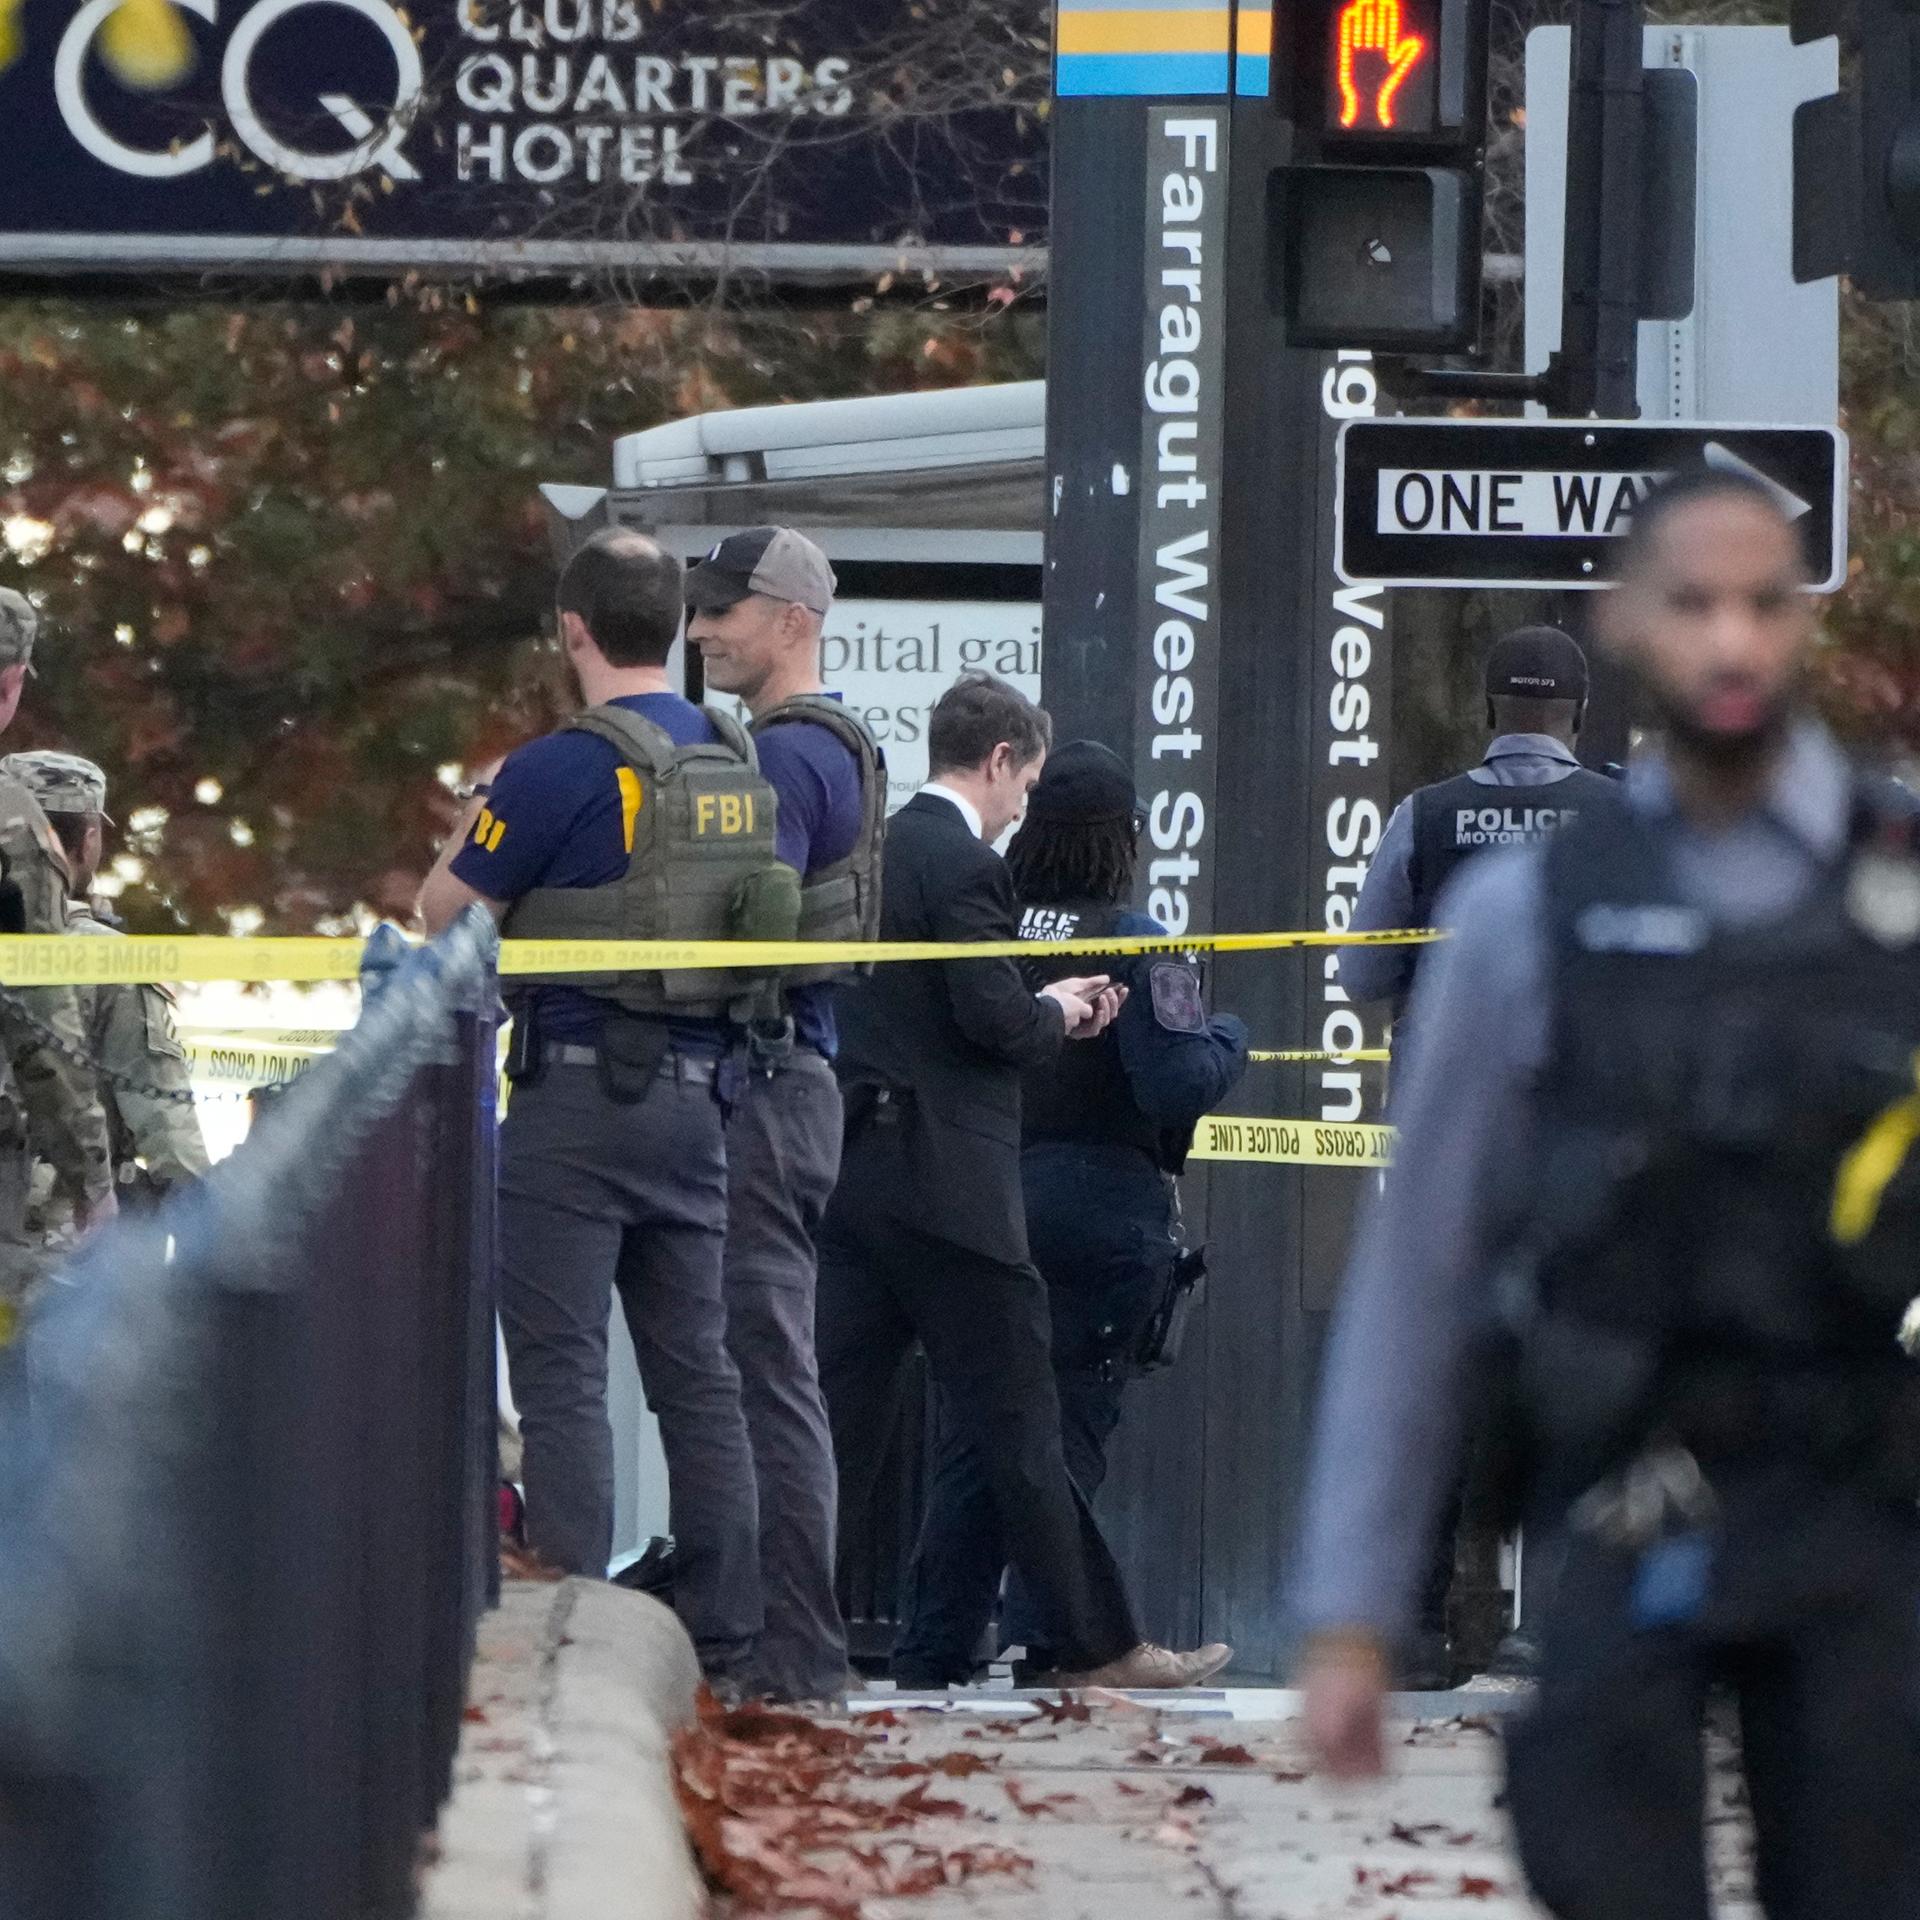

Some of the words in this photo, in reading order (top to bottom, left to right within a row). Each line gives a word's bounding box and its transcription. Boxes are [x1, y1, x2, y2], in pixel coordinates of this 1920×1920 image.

[457, 0, 643, 46] CLUB
[54, 0, 423, 181] CQ
[456, 53, 853, 116] QUARTERS
[457, 122, 693, 185] HOTEL
[1145, 118, 1217, 509] Farragut
[1394, 472, 1524, 532] ONE
[1552, 475, 1655, 533] WA
[818, 622, 944, 685] pital
[958, 626, 1041, 677] gai
[1151, 530, 1209, 761] West
[473, 807, 507, 853] BI
[696, 794, 754, 835] FBI
[1456, 807, 1579, 832] POLICE
[1456, 830, 1525, 845] MOTOR
[1147, 790, 1205, 963] Sta
[1020, 907, 1080, 933] ICE
[208, 1049, 256, 1083] CROSS
[259, 1053, 289, 1085] NOT
[1208, 1123, 1243, 1153] LINE
[1248, 1125, 1300, 1156] POLICE
[1314, 1127, 1366, 1158] CROSS
[1370, 1131, 1393, 1160] OT
